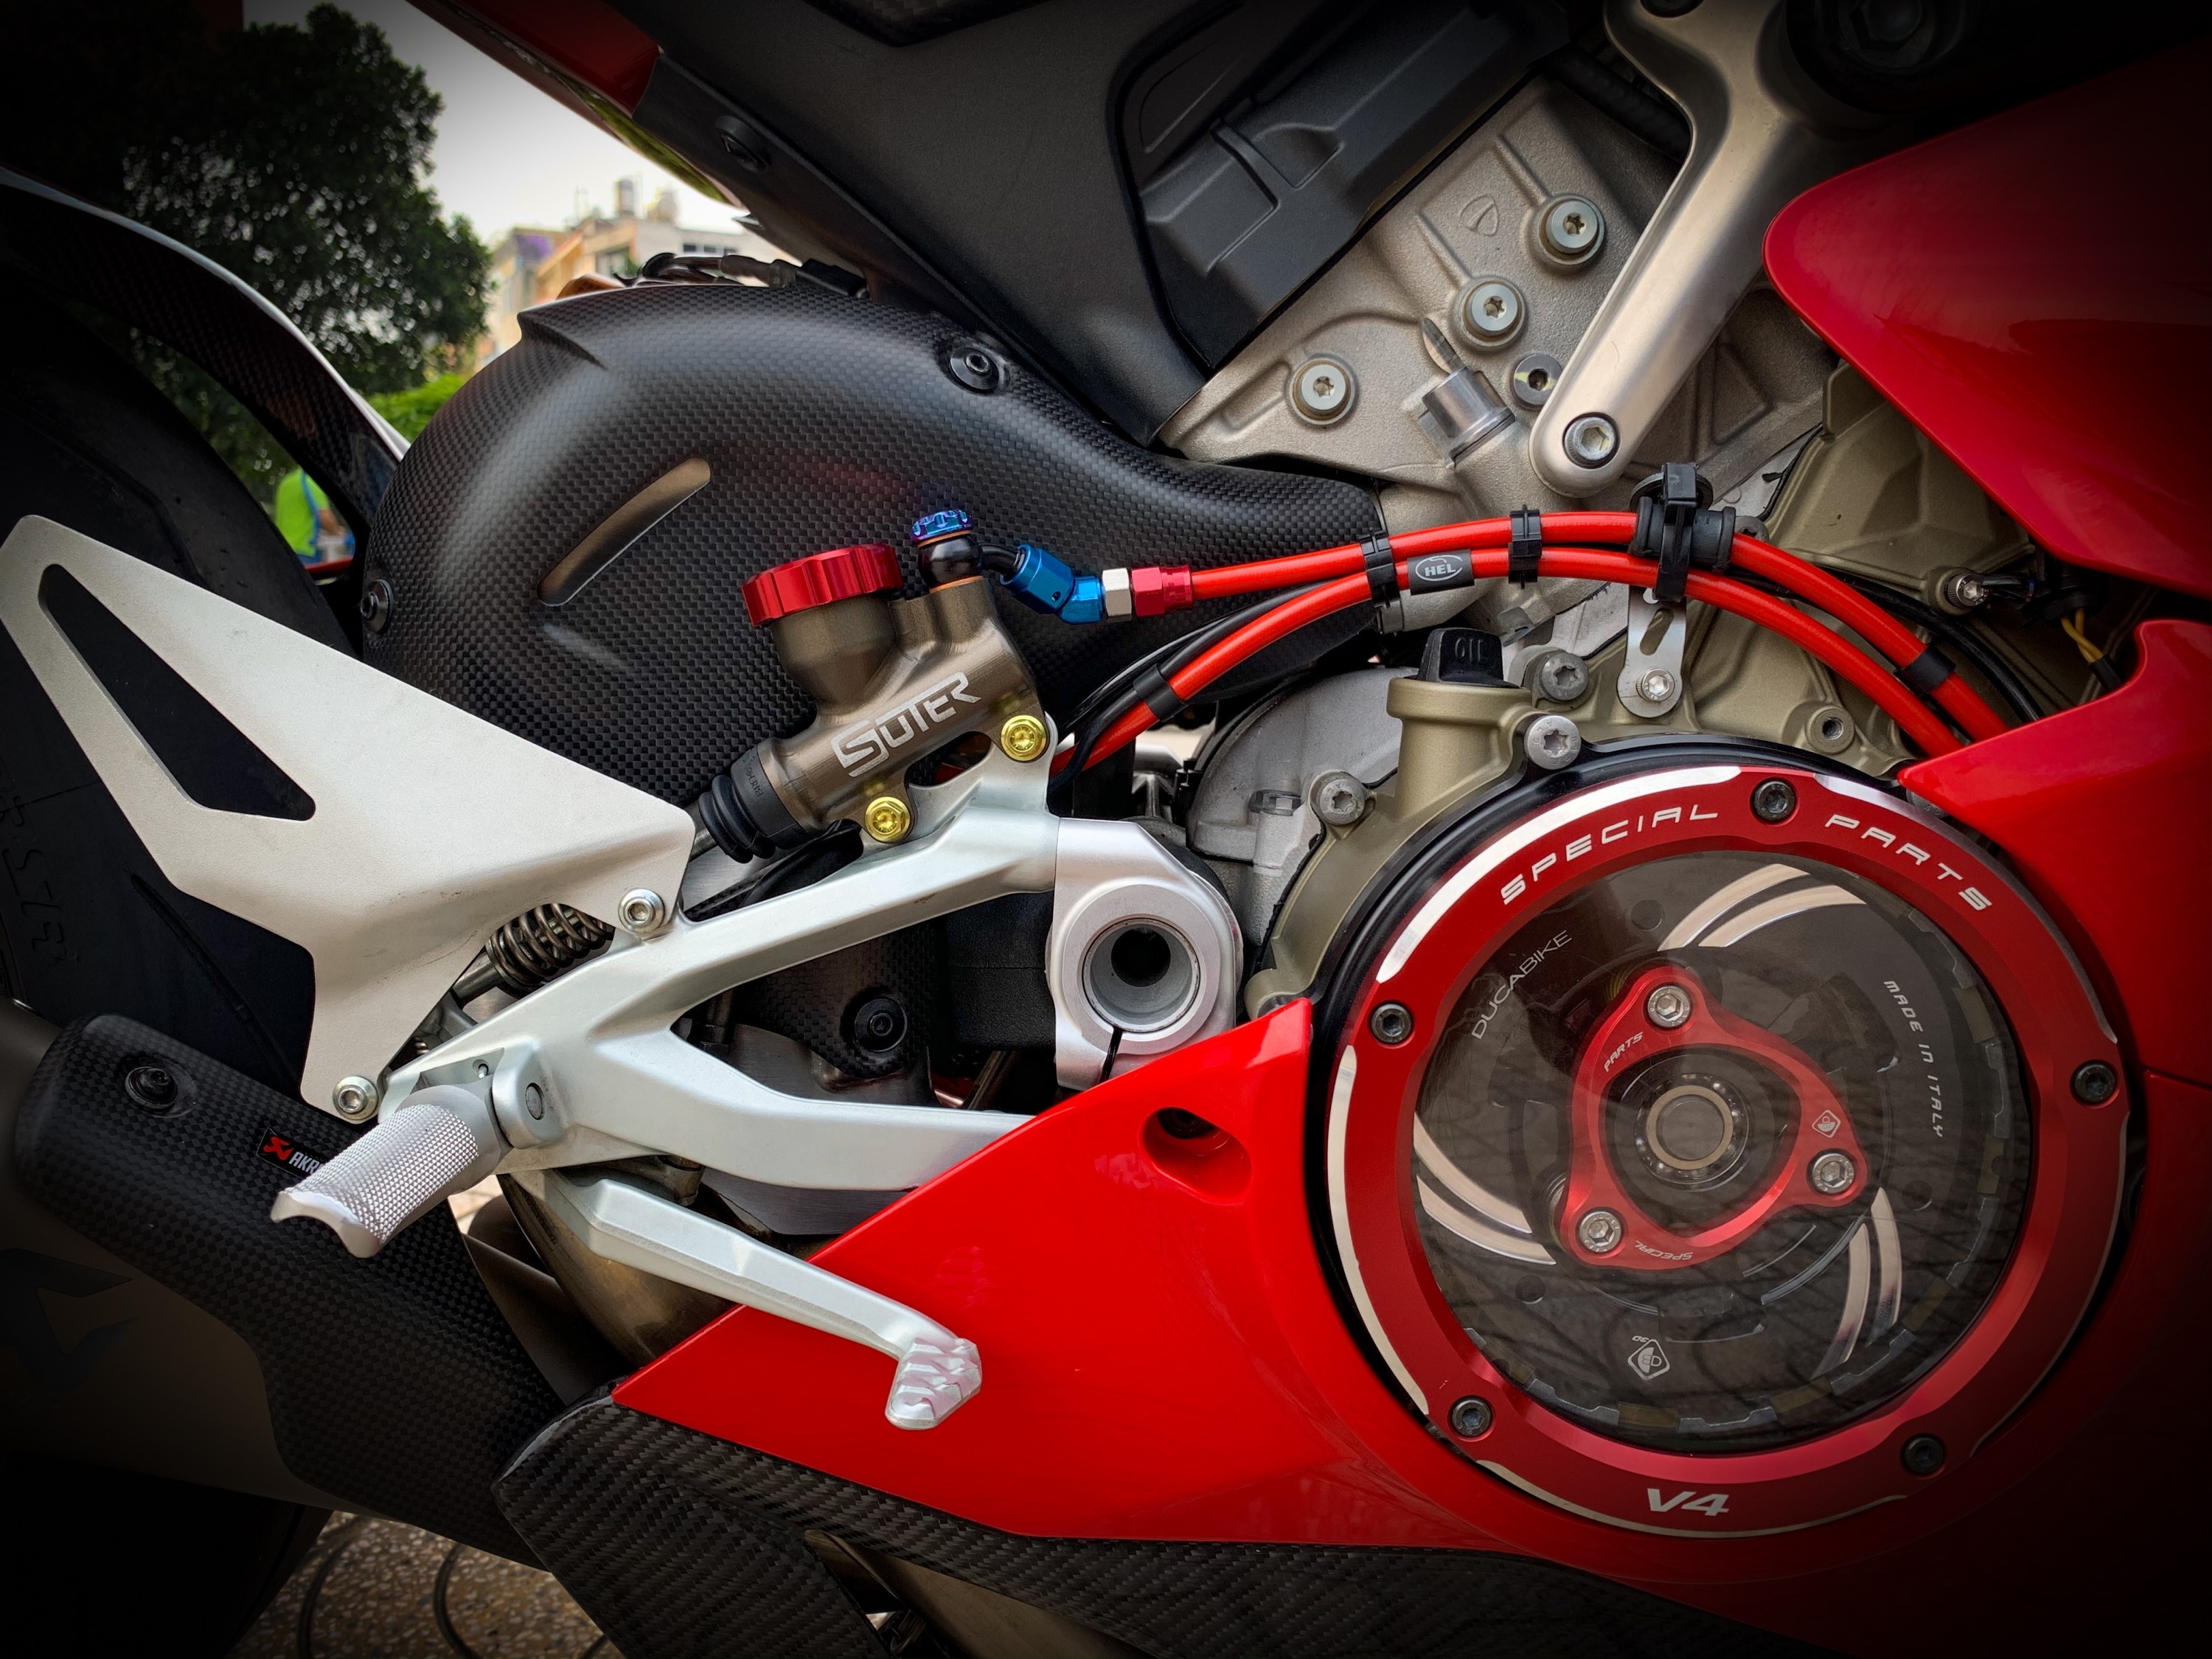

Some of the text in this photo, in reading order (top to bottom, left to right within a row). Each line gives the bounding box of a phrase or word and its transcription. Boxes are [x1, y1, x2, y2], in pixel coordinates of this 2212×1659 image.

[1425, 563, 1456, 577] HEL
[1455, 637, 1489, 662] OIL
[830, 672, 981, 777] SUTER
[1500, 804, 1993, 911] SPECIAL PARTS
[1471, 930, 1572, 1040] DUCABIKE
[1604, 1032, 1643, 1073] PARTS
[1883, 980, 1943, 1138] MADE IN ITALY
[1635, 1240, 1693, 1260] SPECIAL
[1647, 1488, 1730, 1516] V4
